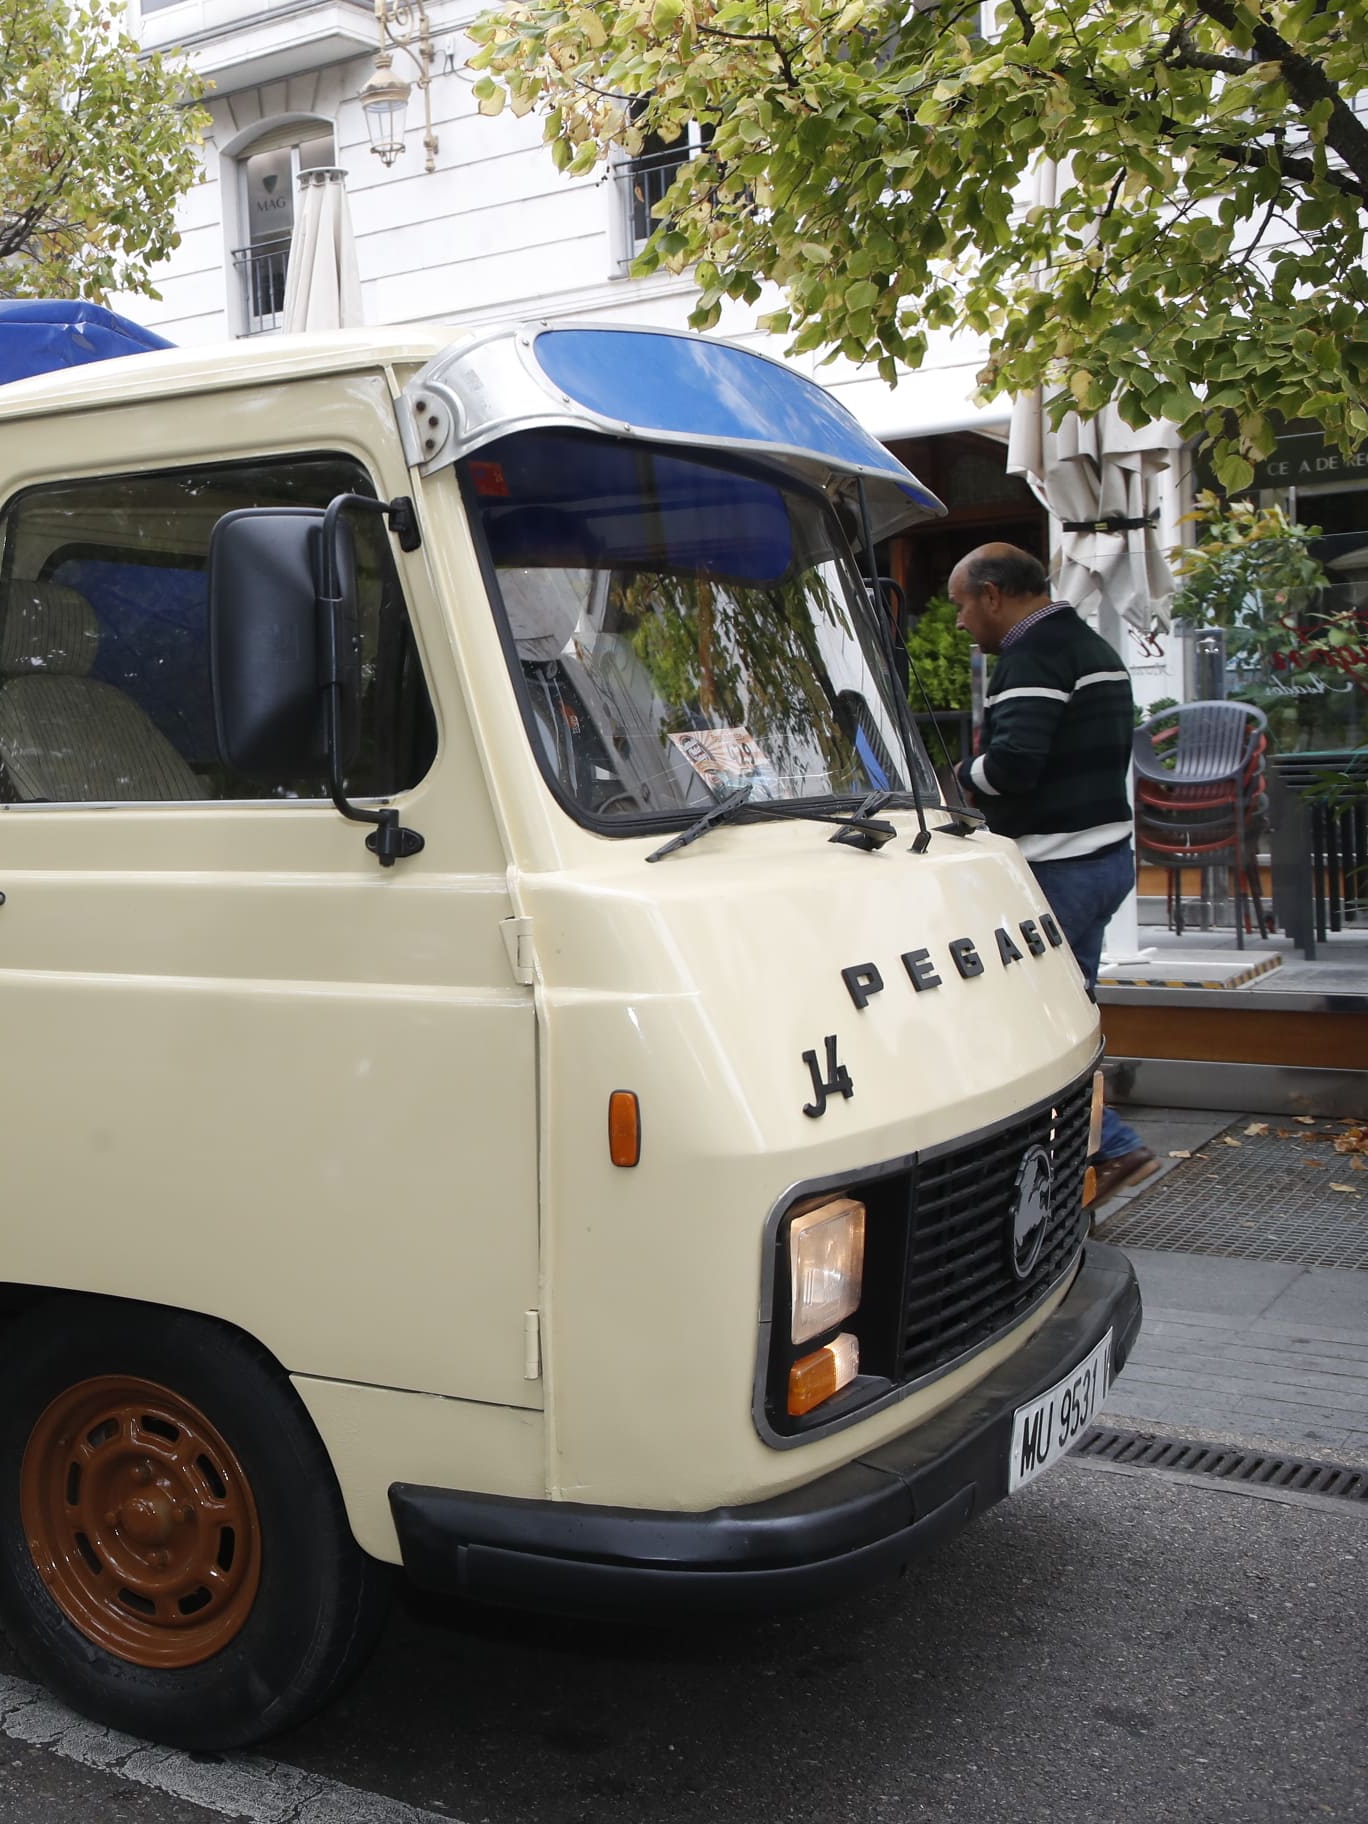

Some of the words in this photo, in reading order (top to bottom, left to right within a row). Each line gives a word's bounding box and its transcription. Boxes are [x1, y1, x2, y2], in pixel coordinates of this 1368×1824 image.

[1316, 455, 1339, 471] DE
[841, 913, 1063, 1010] PEGASO
[801, 1034, 854, 1119] J4
[1020, 1401, 1053, 1478] MU
[1058, 1357, 1098, 1448] 9531
